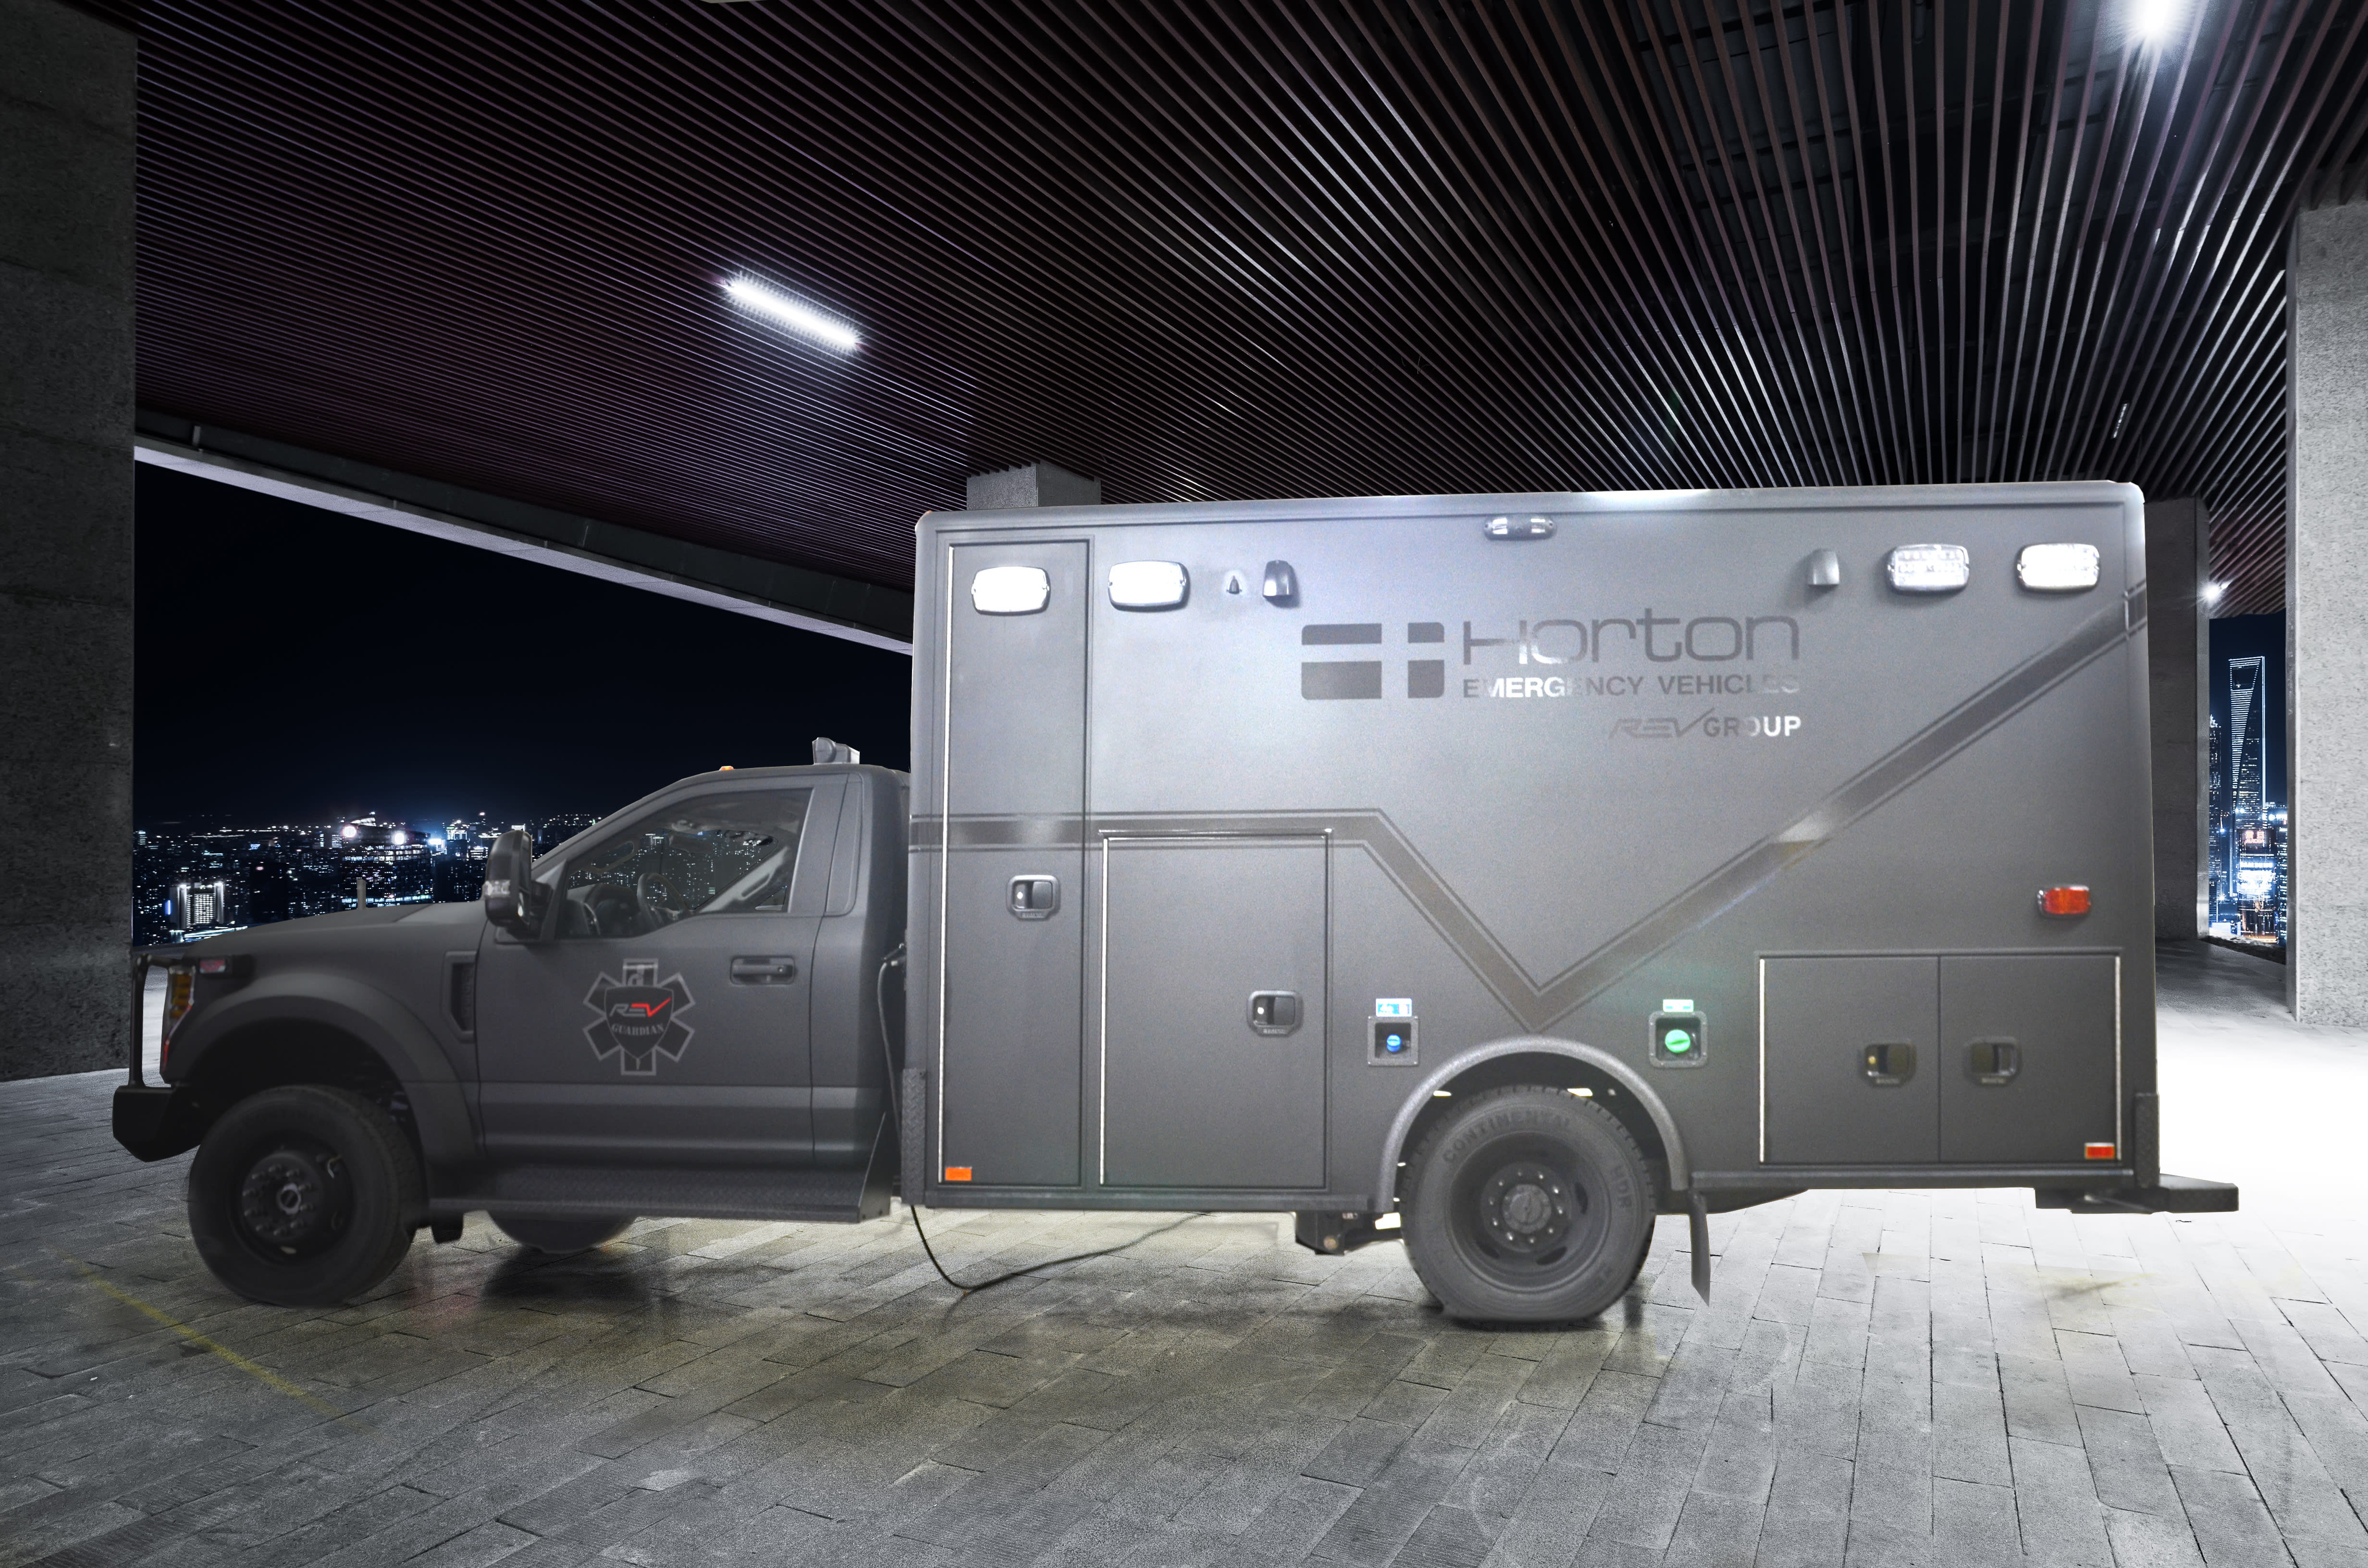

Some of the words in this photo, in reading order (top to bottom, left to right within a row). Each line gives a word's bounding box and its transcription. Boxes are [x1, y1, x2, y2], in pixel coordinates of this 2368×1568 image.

[1463, 608, 1801, 665] Horton
[1464, 676, 1644, 698] EMERGENCY
[1658, 674, 1800, 695] VEHICLES
[1609, 707, 1715, 739] REV
[1703, 716, 1802, 737] GROUP
[609, 997, 671, 1017] REV
[611, 1023, 665, 1036] GUARDIAN
